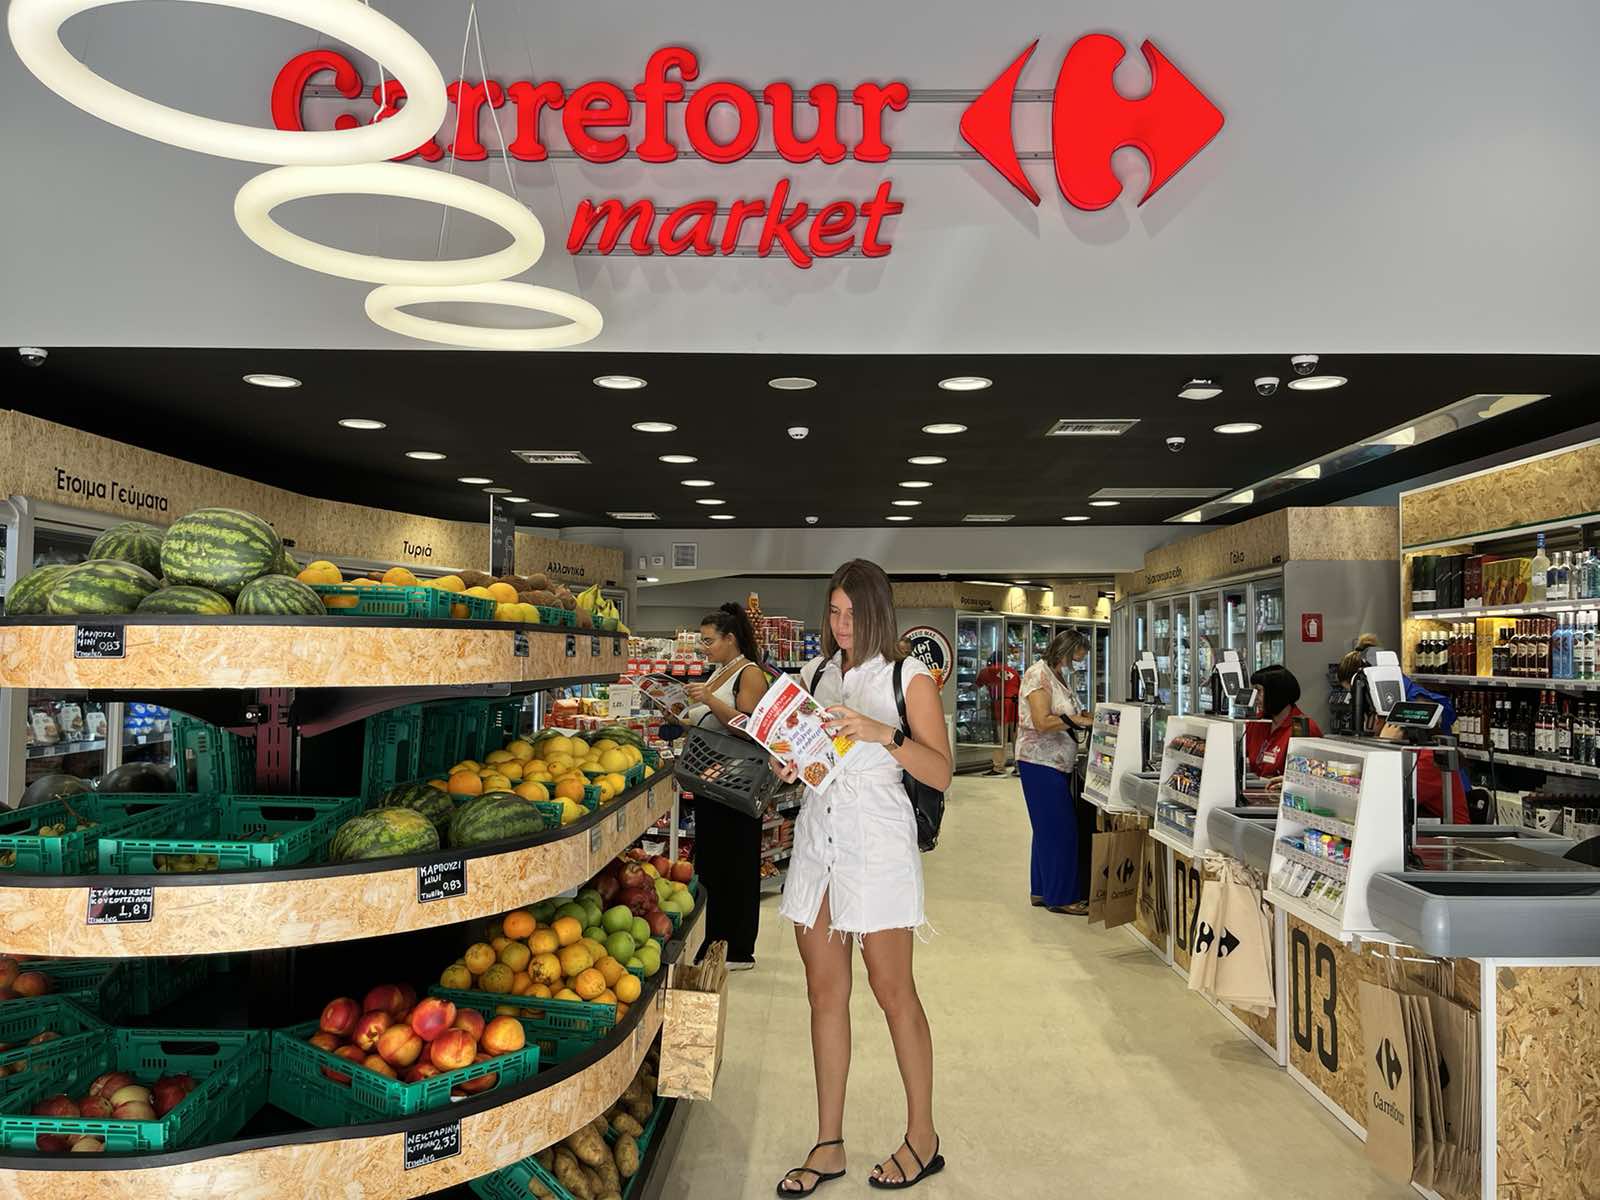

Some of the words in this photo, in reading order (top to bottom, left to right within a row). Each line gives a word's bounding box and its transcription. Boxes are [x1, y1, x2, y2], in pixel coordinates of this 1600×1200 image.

[566, 178, 905, 269] market
[55, 467, 107, 500] Έτοιμα
[111, 480, 168, 512] Γεύματα
[403, 540, 433, 559] Τυριά
[546, 561, 585, 577] Αλλαντικά
[442, 879, 462, 891] 0,83
[118, 903, 149, 918] 1,89
[1292, 927, 1338, 1073] 03
